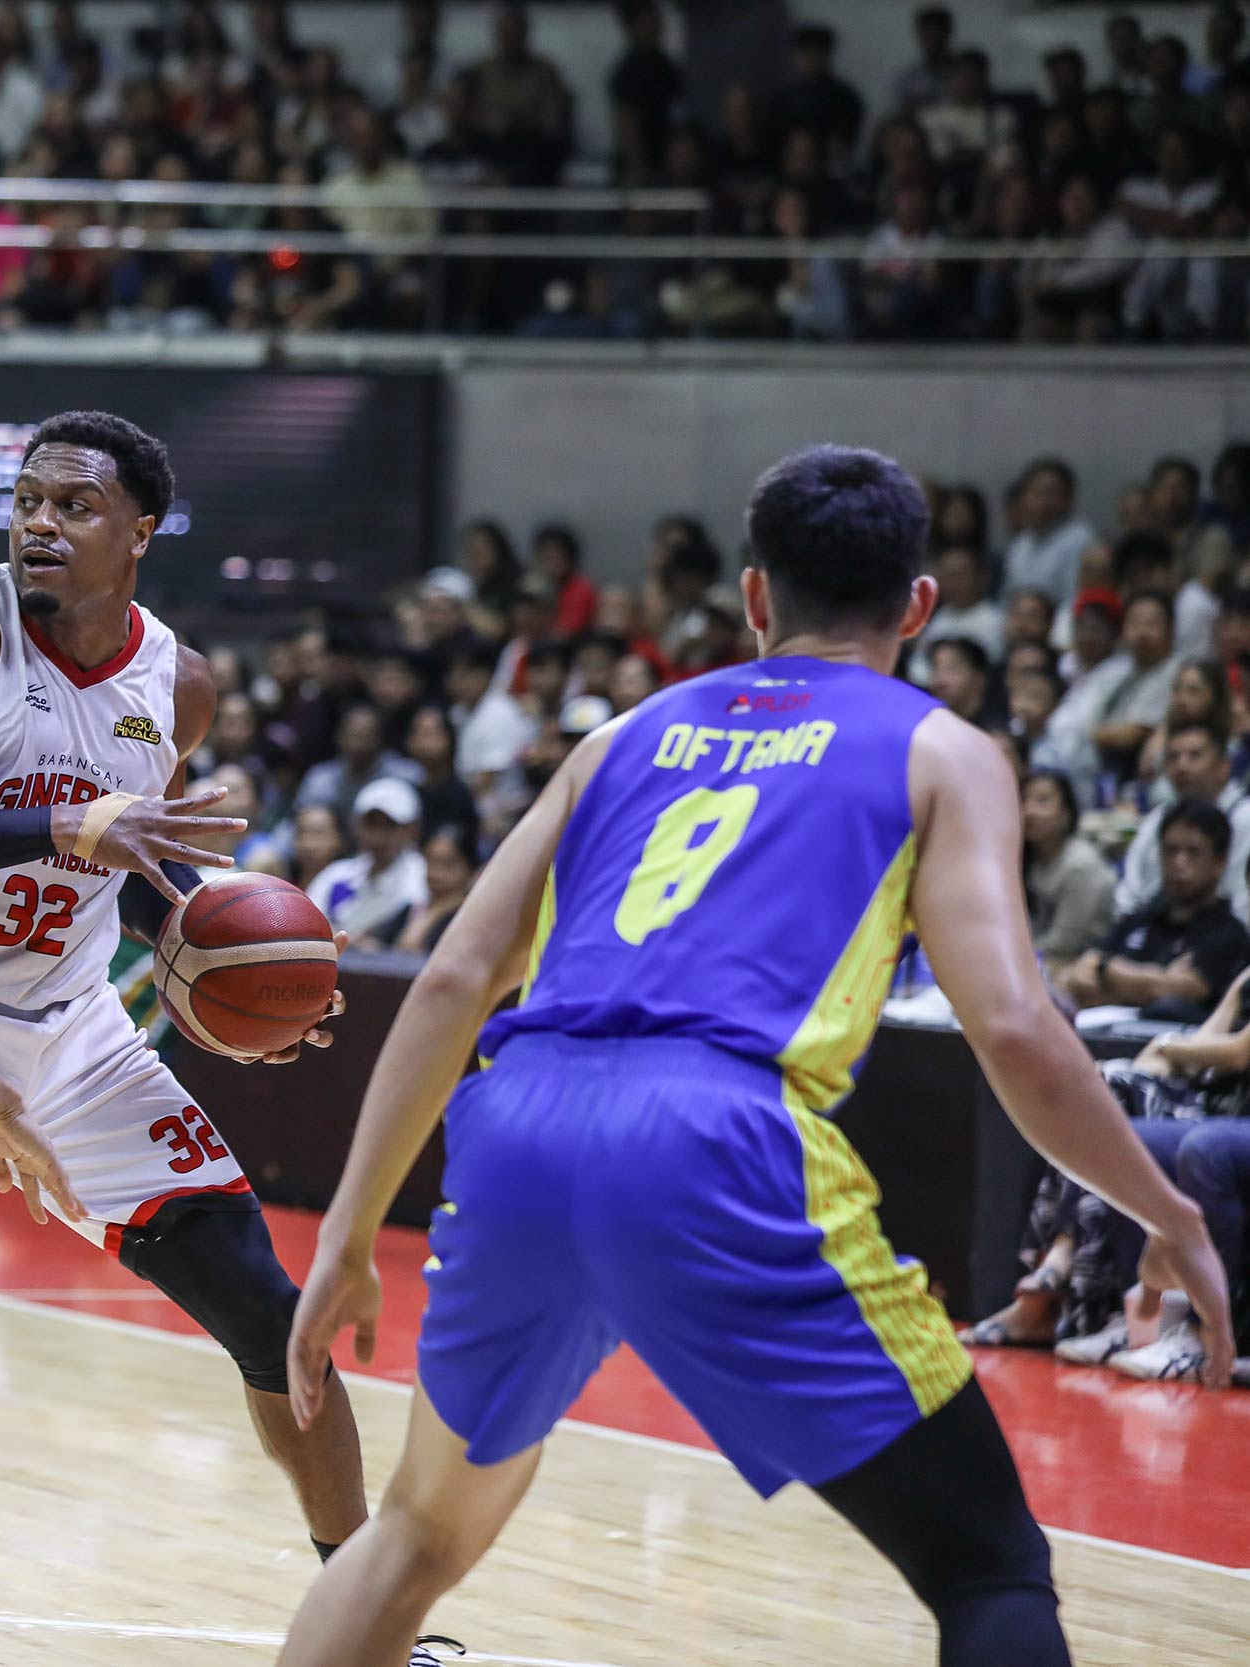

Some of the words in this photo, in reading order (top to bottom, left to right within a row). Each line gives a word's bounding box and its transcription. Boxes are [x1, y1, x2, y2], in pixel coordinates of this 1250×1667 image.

[115, 723, 160, 744] FINALS
[652, 720, 838, 774] OFTANA
[37, 754, 123, 789] BARANGAY
[613, 783, 760, 947] 8
[148, 1104, 230, 1174] 32
